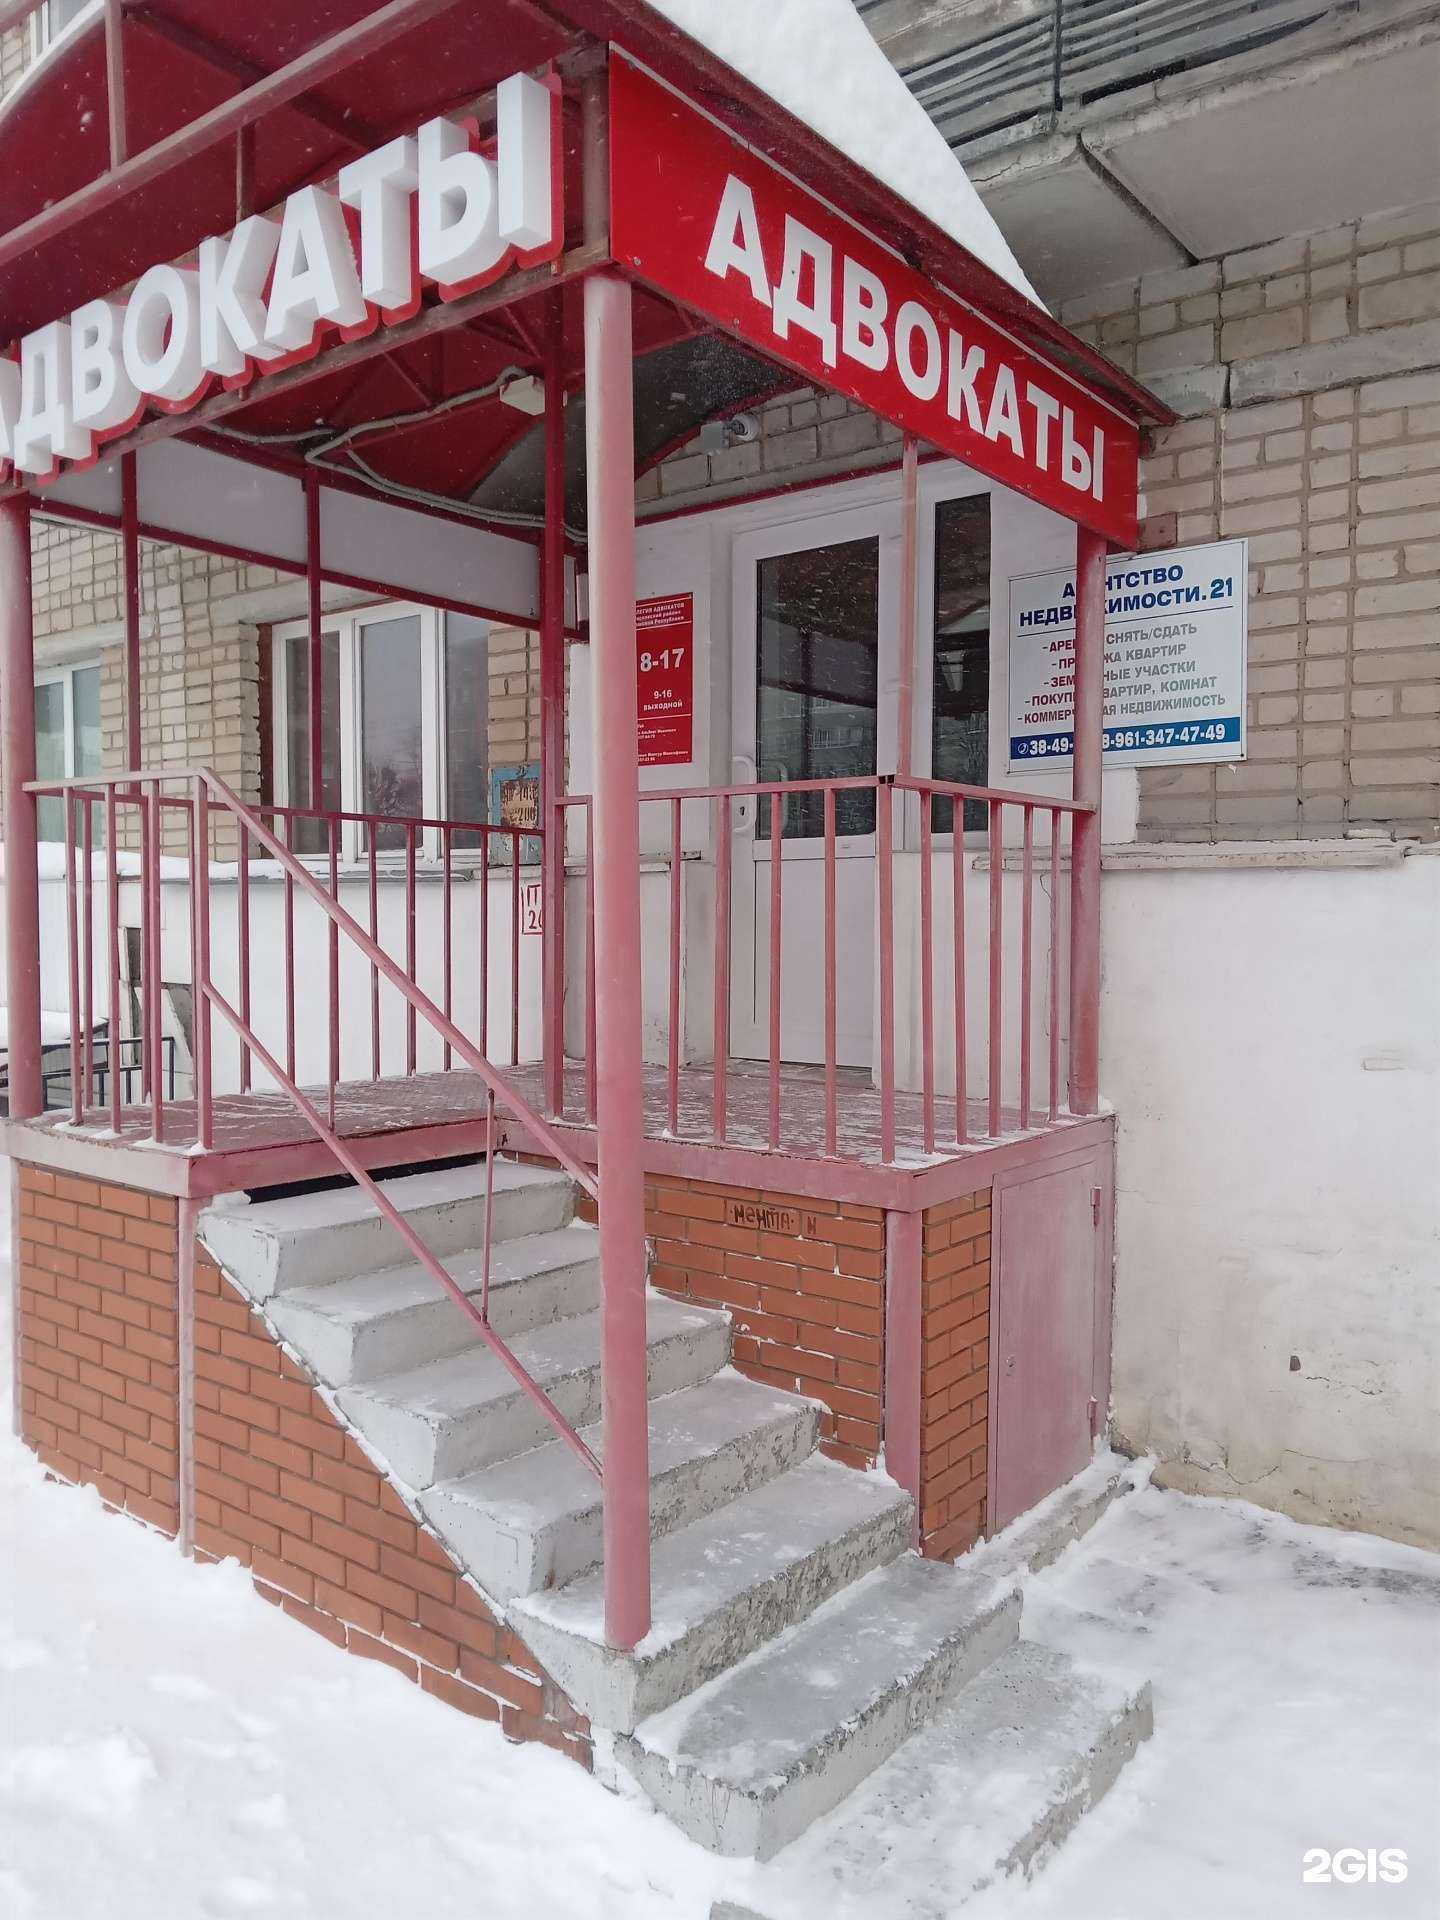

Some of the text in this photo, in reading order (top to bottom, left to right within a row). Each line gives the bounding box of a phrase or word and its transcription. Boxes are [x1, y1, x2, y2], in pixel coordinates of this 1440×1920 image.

[704, 173, 1105, 502] АДВОКАТЫ
[1062, 564, 1183, 598] АНТСТВО
[1106, 623, 1197, 645] СНЯТЬ/СДАТЬ
[640, 647, 685, 672] 8-17
[1126, 643, 1187, 661] КВАРТИР
[1135, 660, 1196, 679] УЧАСТКИ
[653, 689, 672, 699] 9-16
[1102, 683, 1156, 699] ВАРТИР,
[1160, 676, 1218, 693] КОМНАТ
[643, 698, 683, 711] ВЫХОДНОЙ
[1120, 694, 1226, 714] НЕДВИЖИМОСТЬ
